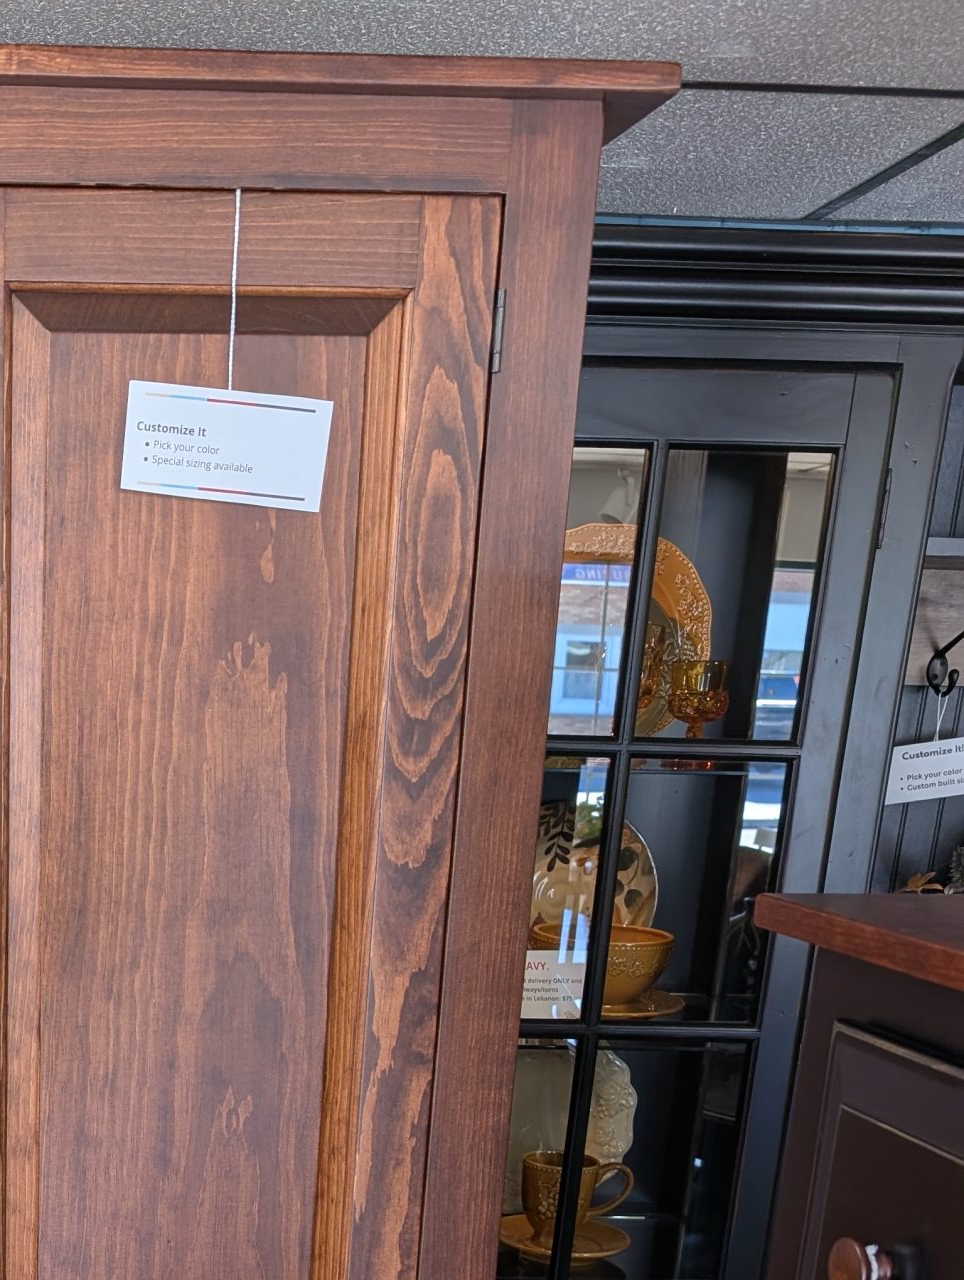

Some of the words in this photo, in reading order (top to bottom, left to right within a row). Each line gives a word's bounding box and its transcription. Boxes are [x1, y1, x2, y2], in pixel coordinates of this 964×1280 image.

[137, 420, 195, 437] Customize
[198, 426, 207, 438] It
[153, 440, 172, 451] Pick
[174, 443, 195, 455] your
[197, 445, 220, 456] color
[152, 455, 184, 467] Special
[186, 457, 212, 472] sizing
[214, 461, 254, 474] available
[902, 746, 953, 760] Customize
[907, 773, 923, 781] Pick
[924, 771, 942, 780] your
[943, 768, 963, 776] color
[907, 782, 937, 791] Custom
[938, 778, 956, 787] built
[526, 961, 550, 971] AVY.
